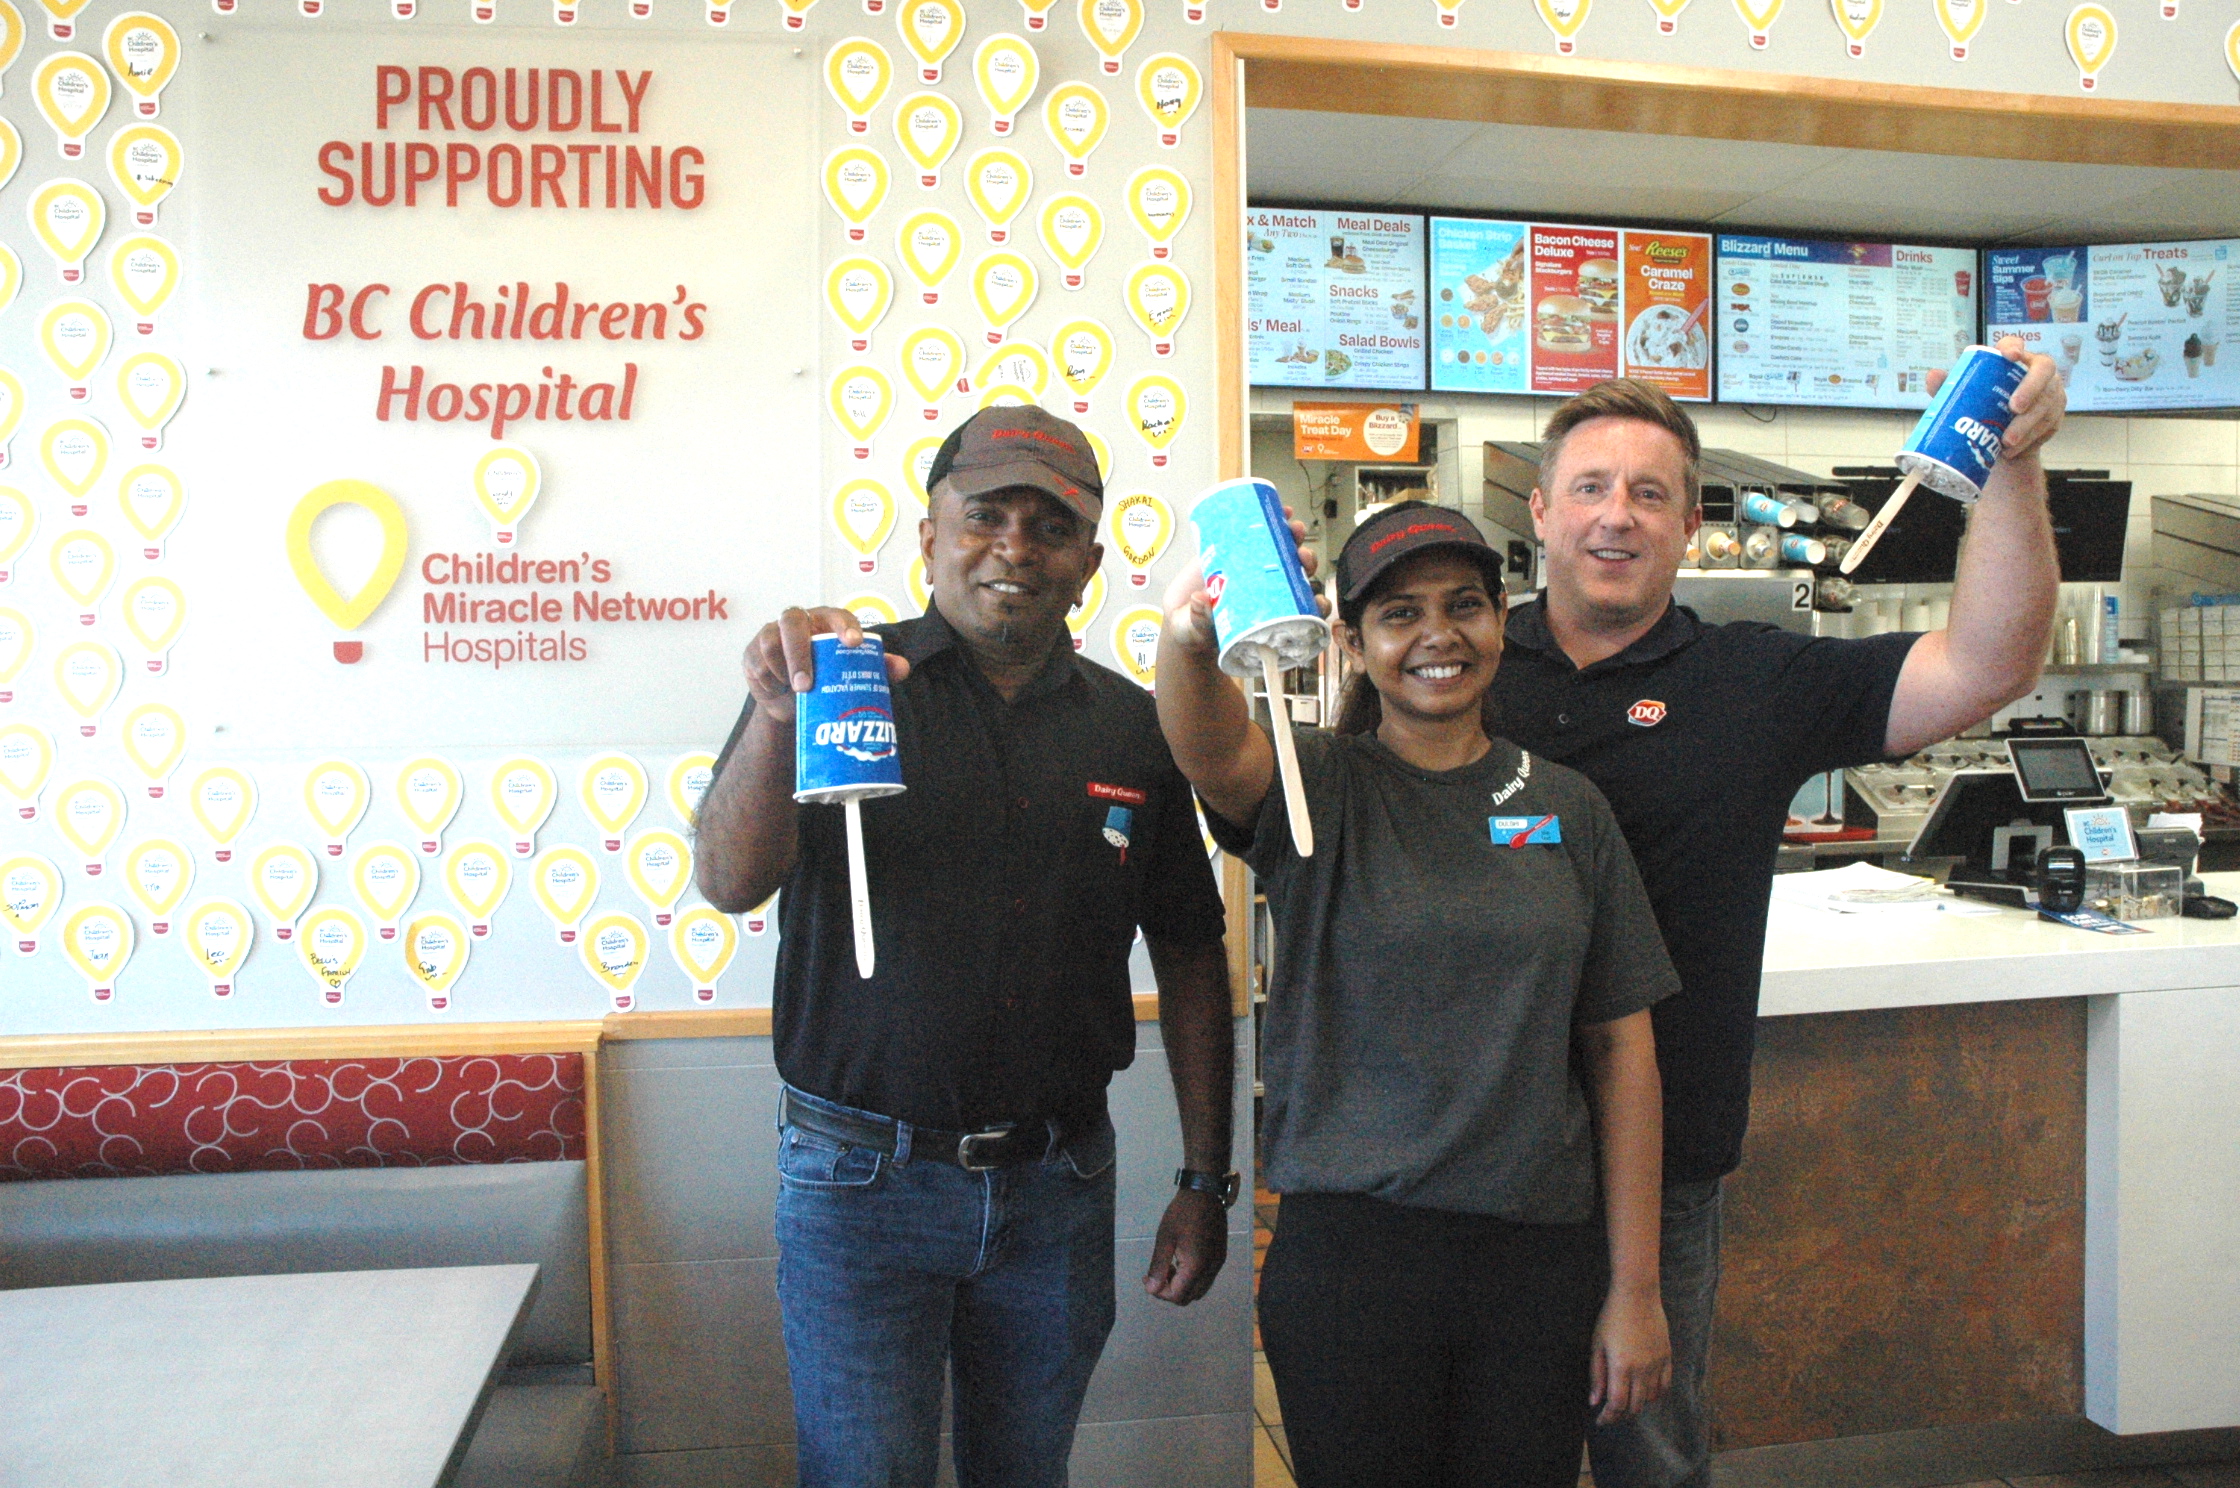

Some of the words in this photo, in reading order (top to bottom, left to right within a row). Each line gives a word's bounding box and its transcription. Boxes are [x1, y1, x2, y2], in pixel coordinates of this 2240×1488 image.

[376, 65, 653, 133] PROUDLY
[317, 141, 705, 210] SUPPORTING
[1258, 214, 1269, 226] &
[1272, 215, 1317, 228] Match
[1338, 218, 1370, 230] Meal
[1374, 219, 1411, 233] Deals
[1535, 234, 1571, 245] Bacon
[1572, 236, 1615, 248] Cheese
[1722, 239, 1770, 254] Blizzard
[1774, 243, 1808, 256] Menu
[1535, 246, 1574, 258] Deluxe
[1896, 250, 1933, 263] Drinks
[2143, 247, 2188, 259] Treats
[1641, 265, 1693, 279] Caramel
[1992, 265, 2035, 274] Summer
[1648, 278, 1686, 291] Craze
[1992, 275, 2014, 284] Sips
[1329, 285, 1378, 298] Snacks
[302, 283, 390, 341] BC
[409, 281, 707, 341] Children's
[1266, 319, 1301, 332] Meal
[1339, 334, 1376, 347] Salad
[1380, 336, 1420, 349] Bowls
[376, 362, 638, 440] Hospital
[1300, 414, 1340, 424] Miracle
[1301, 425, 1330, 435] Treat
[1331, 426, 1352, 437] Day
[1124, 546, 1154, 564] GORDON
[422, 551, 612, 585] Children's
[1794, 584, 1809, 609] 2
[423, 591, 562, 624] Miracle
[573, 589, 728, 622] Network
[424, 630, 587, 669] Hospitals
[1634, 706, 1660, 720] DQ
[1491, 776, 1525, 806] Dairy
[1517, 750, 1531, 778] Queen
[1094, 784, 1116, 796] Dairy
[2084, 826, 2117, 835] Children's
[2086, 835, 2114, 843] Hospital
